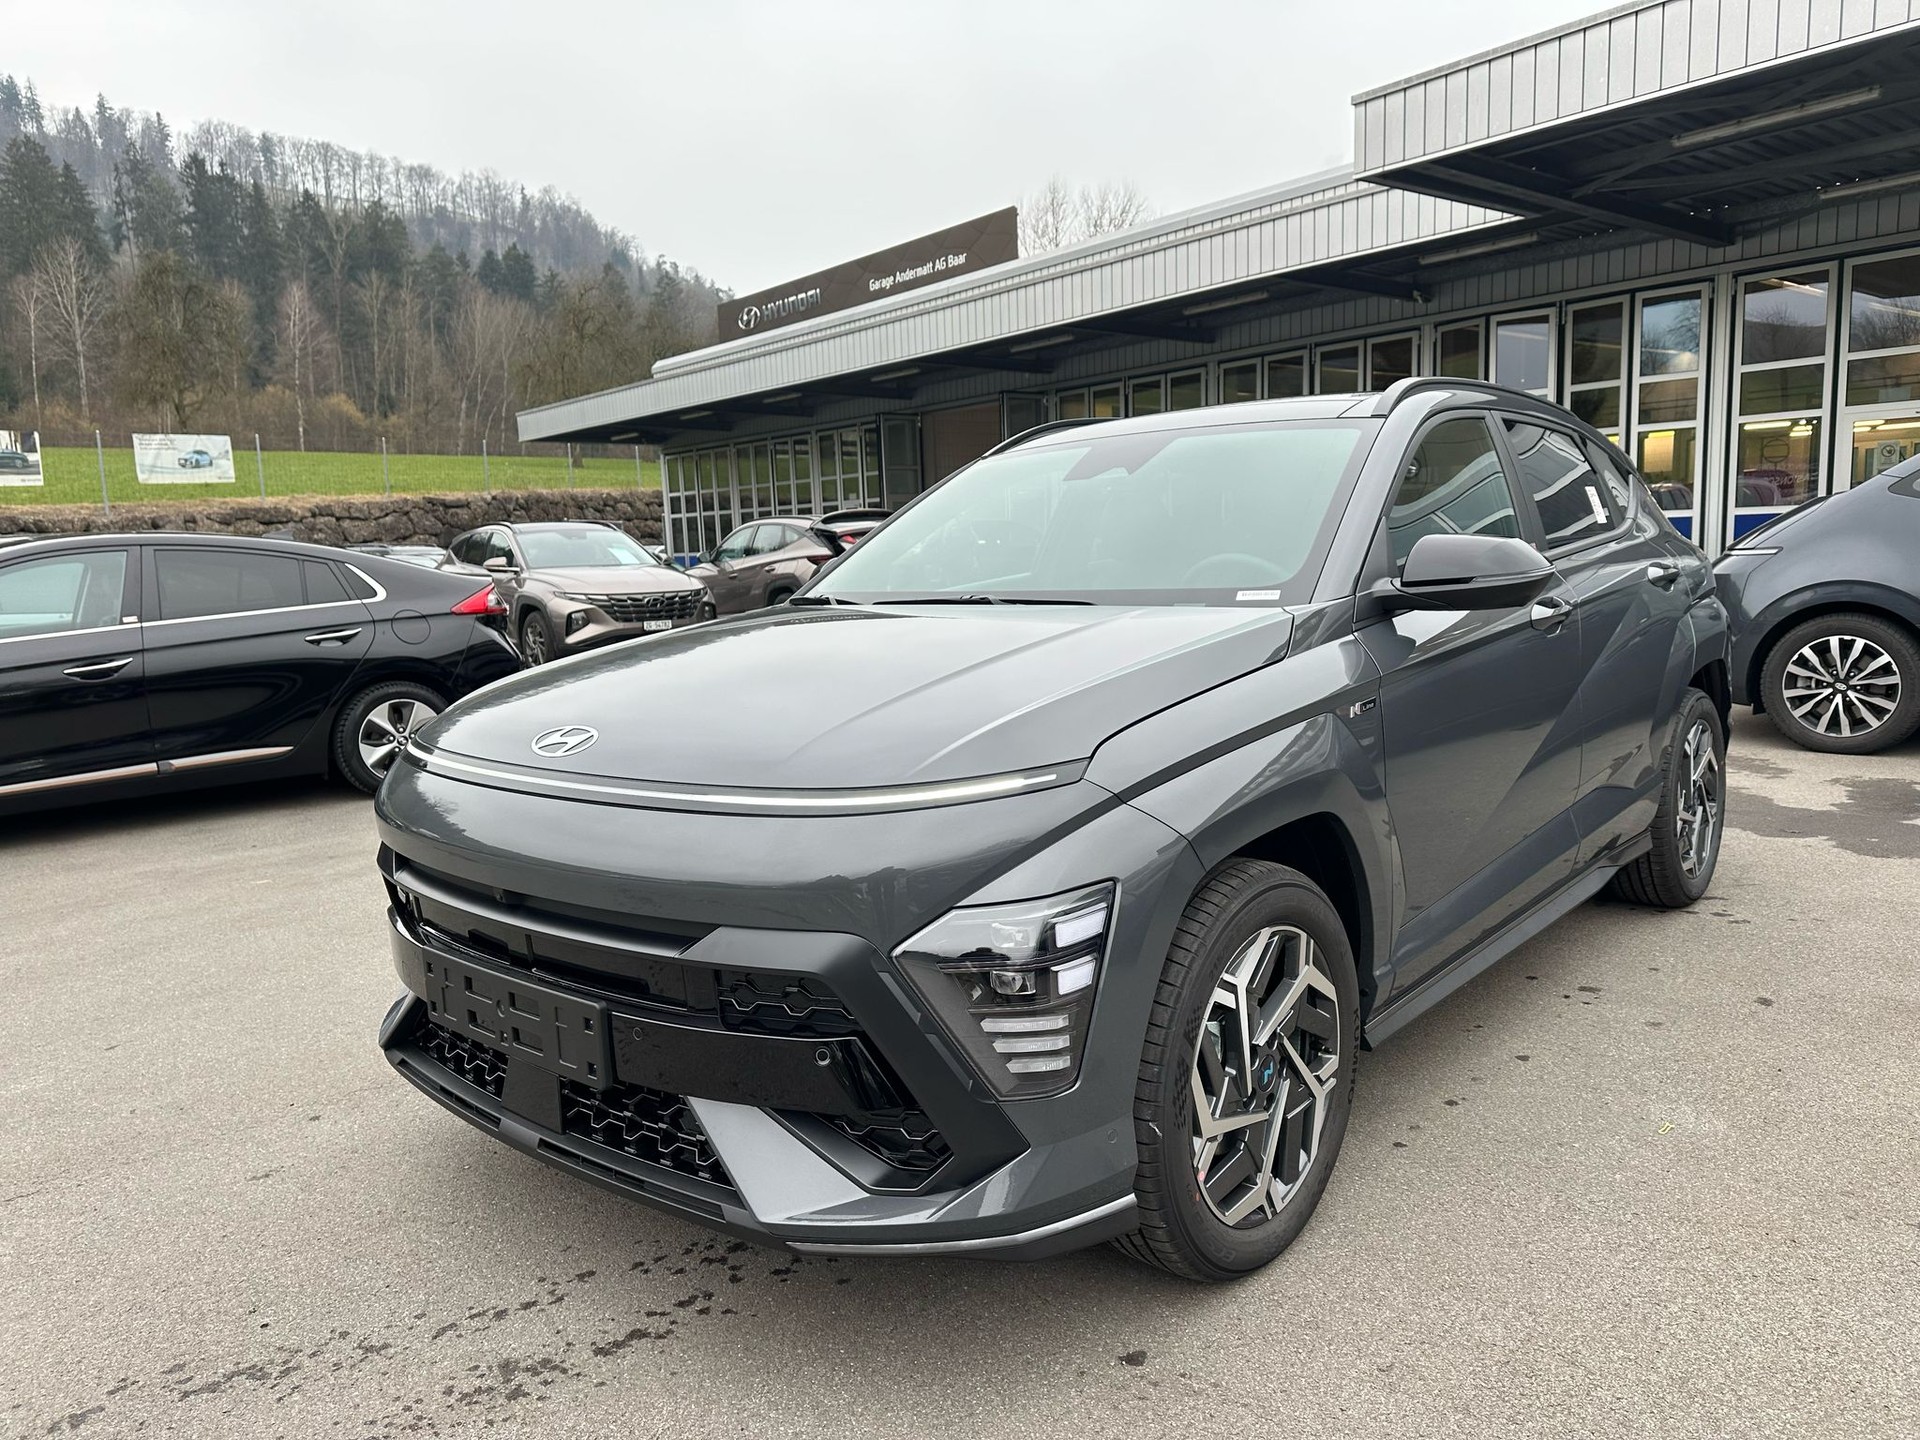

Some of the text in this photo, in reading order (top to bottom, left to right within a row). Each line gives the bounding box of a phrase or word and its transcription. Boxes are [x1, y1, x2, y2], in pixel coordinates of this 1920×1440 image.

[869, 252, 968, 292] Garage Andermatt AG Baar
[762, 288, 820, 321] HYUNDAI
[1347, 1007, 1360, 1105] KUMHO
